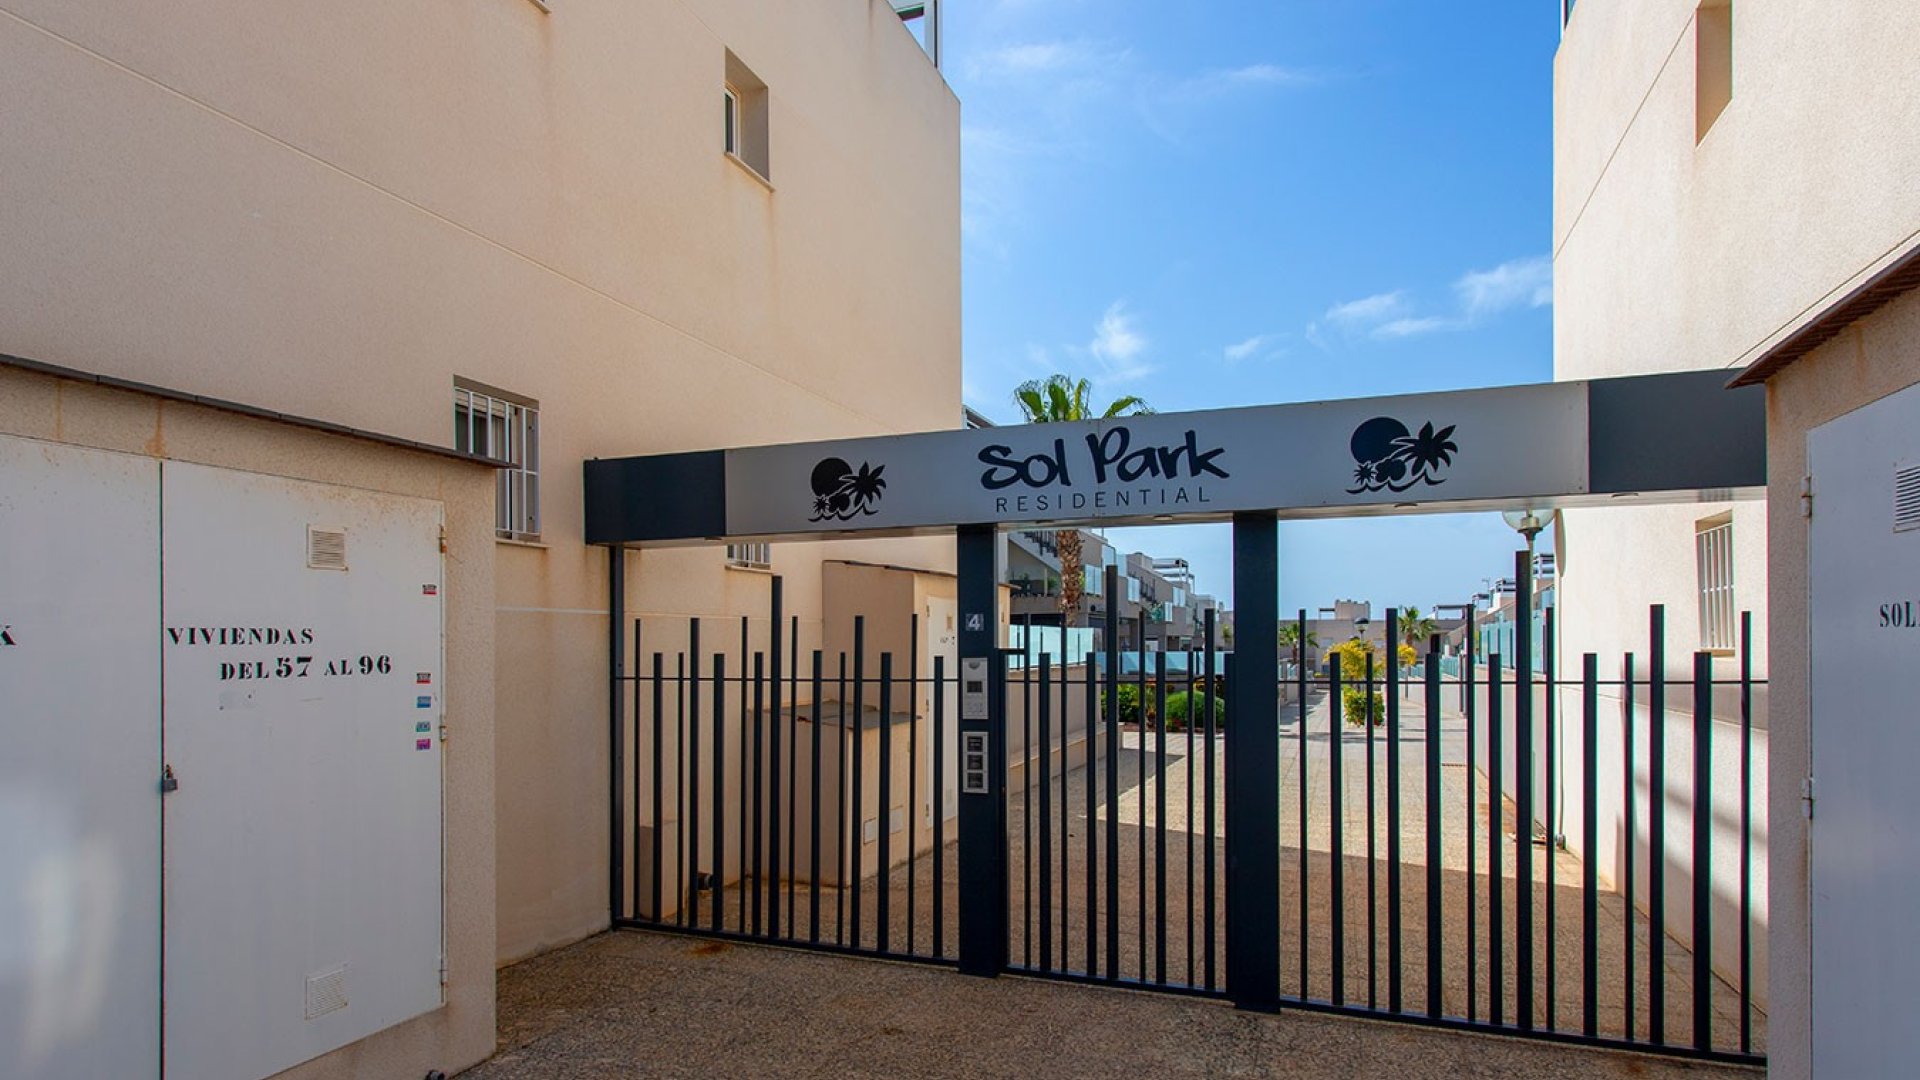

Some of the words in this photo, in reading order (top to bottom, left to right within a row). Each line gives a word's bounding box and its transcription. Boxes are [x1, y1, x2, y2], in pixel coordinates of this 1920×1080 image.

[978, 438, 1071, 490] Sol
[1085, 426, 1230, 484] Park
[996, 486, 1210, 513] RESIDENTIAL
[967, 613, 981, 631] 4
[1879, 600, 1920, 628] SOL
[167, 627, 314, 645] VIVIENDAS
[220, 661, 270, 680] DEL
[275, 656, 312, 678] 57
[324, 659, 353, 676] AL
[358, 655, 391, 675] 96
